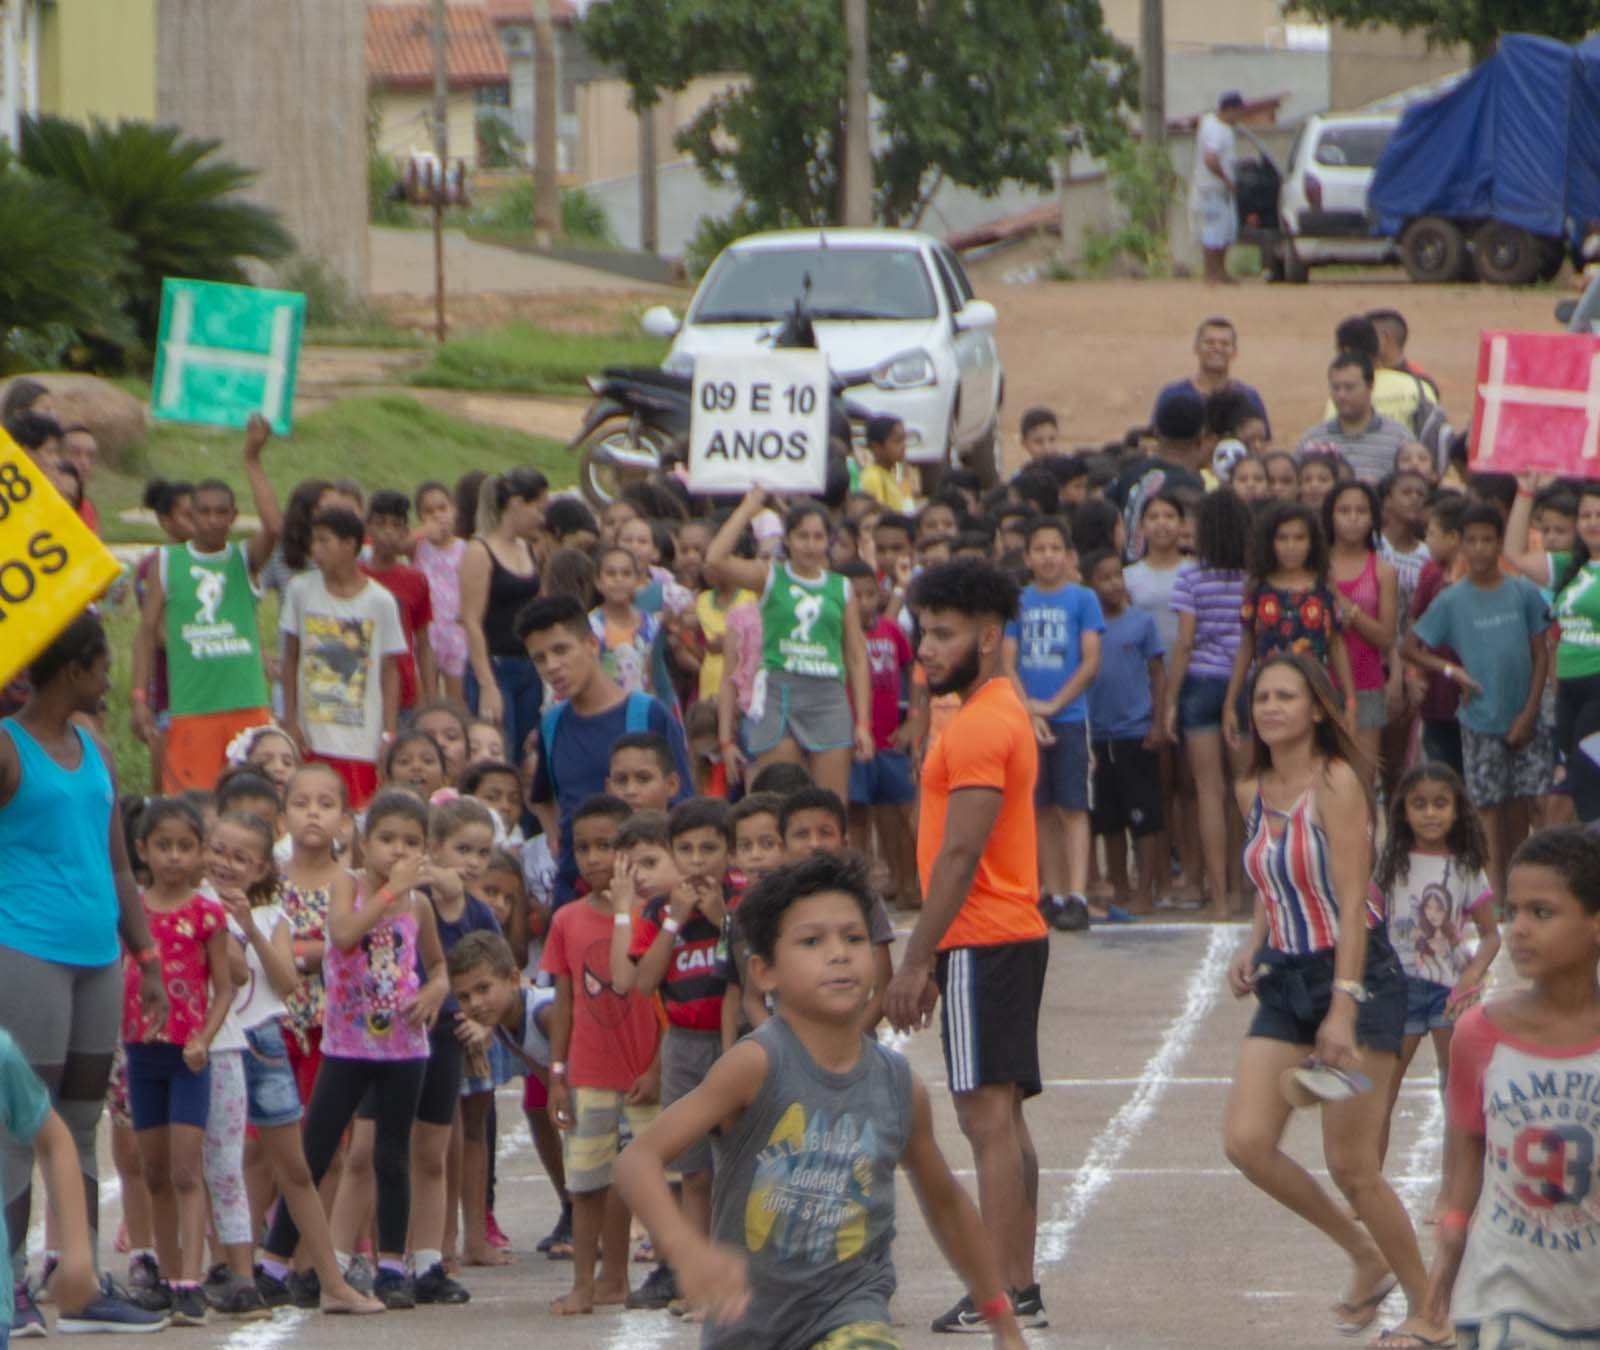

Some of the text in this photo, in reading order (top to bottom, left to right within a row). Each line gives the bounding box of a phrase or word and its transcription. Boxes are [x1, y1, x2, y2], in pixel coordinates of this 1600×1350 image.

[701, 381, 816, 414] 09 E 10
[703, 430, 808, 461] ANOS
[1513, 1125, 1595, 1210] 93
